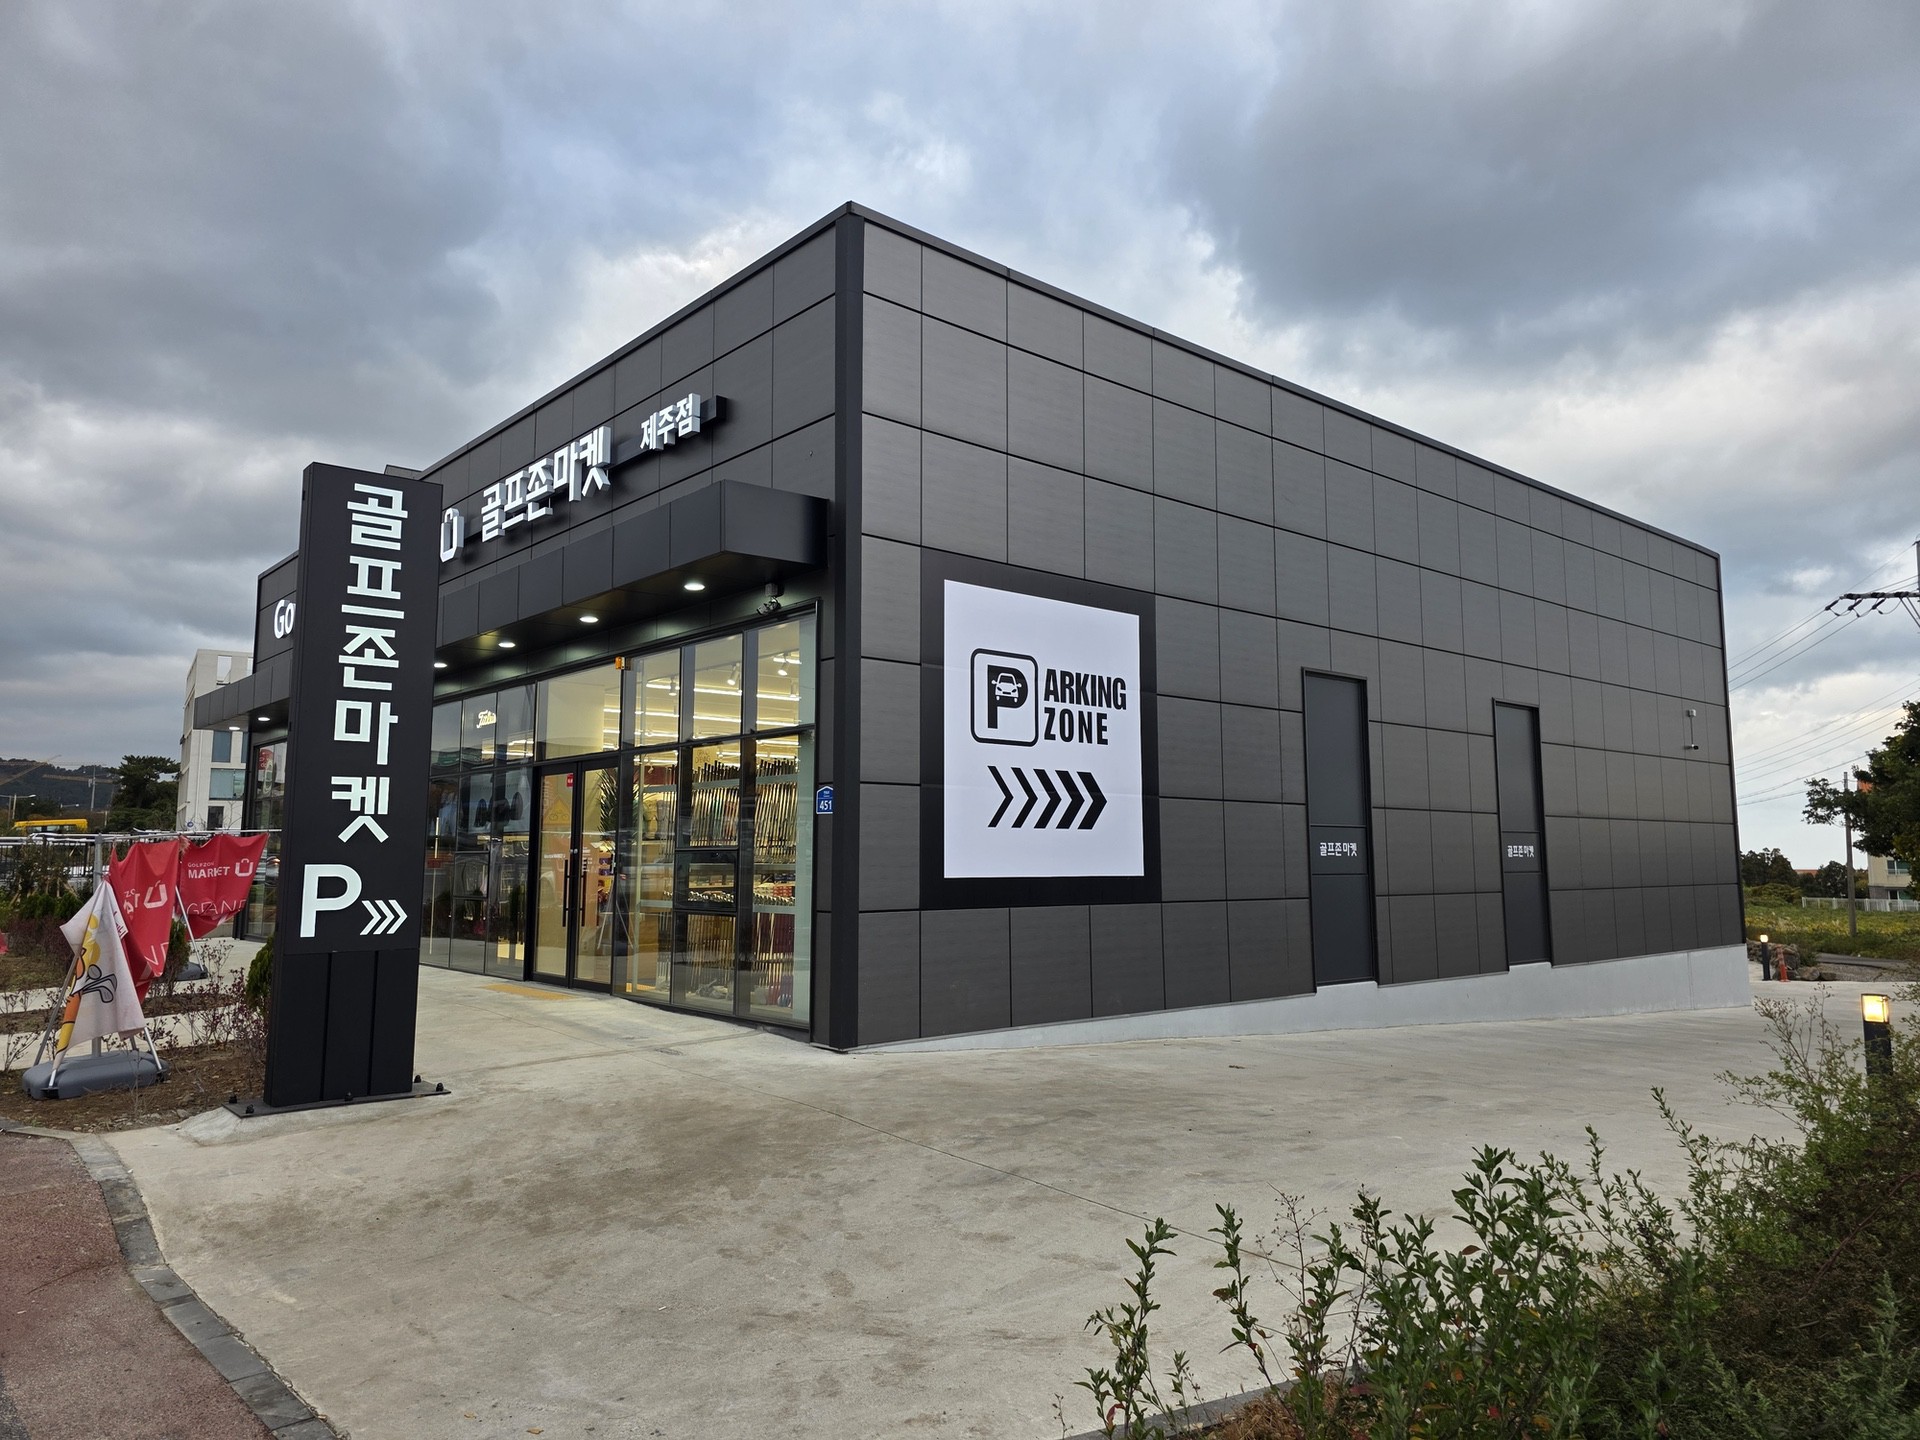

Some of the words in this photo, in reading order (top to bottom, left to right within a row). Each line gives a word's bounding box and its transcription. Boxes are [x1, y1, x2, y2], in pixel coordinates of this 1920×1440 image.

[481, 426, 611, 542] 골프존마켓
[640, 393, 701, 450] 제주점
[331, 483, 408, 843] 골프존마켓
[1044, 706, 1109, 746] ZONE
[820, 800, 832, 811] 451
[1320, 842, 1358, 857] 골프존마켓
[1507, 845, 1534, 858] 골프존마켓
[188, 866, 230, 879] MARKET
[300, 864, 361, 938] P
